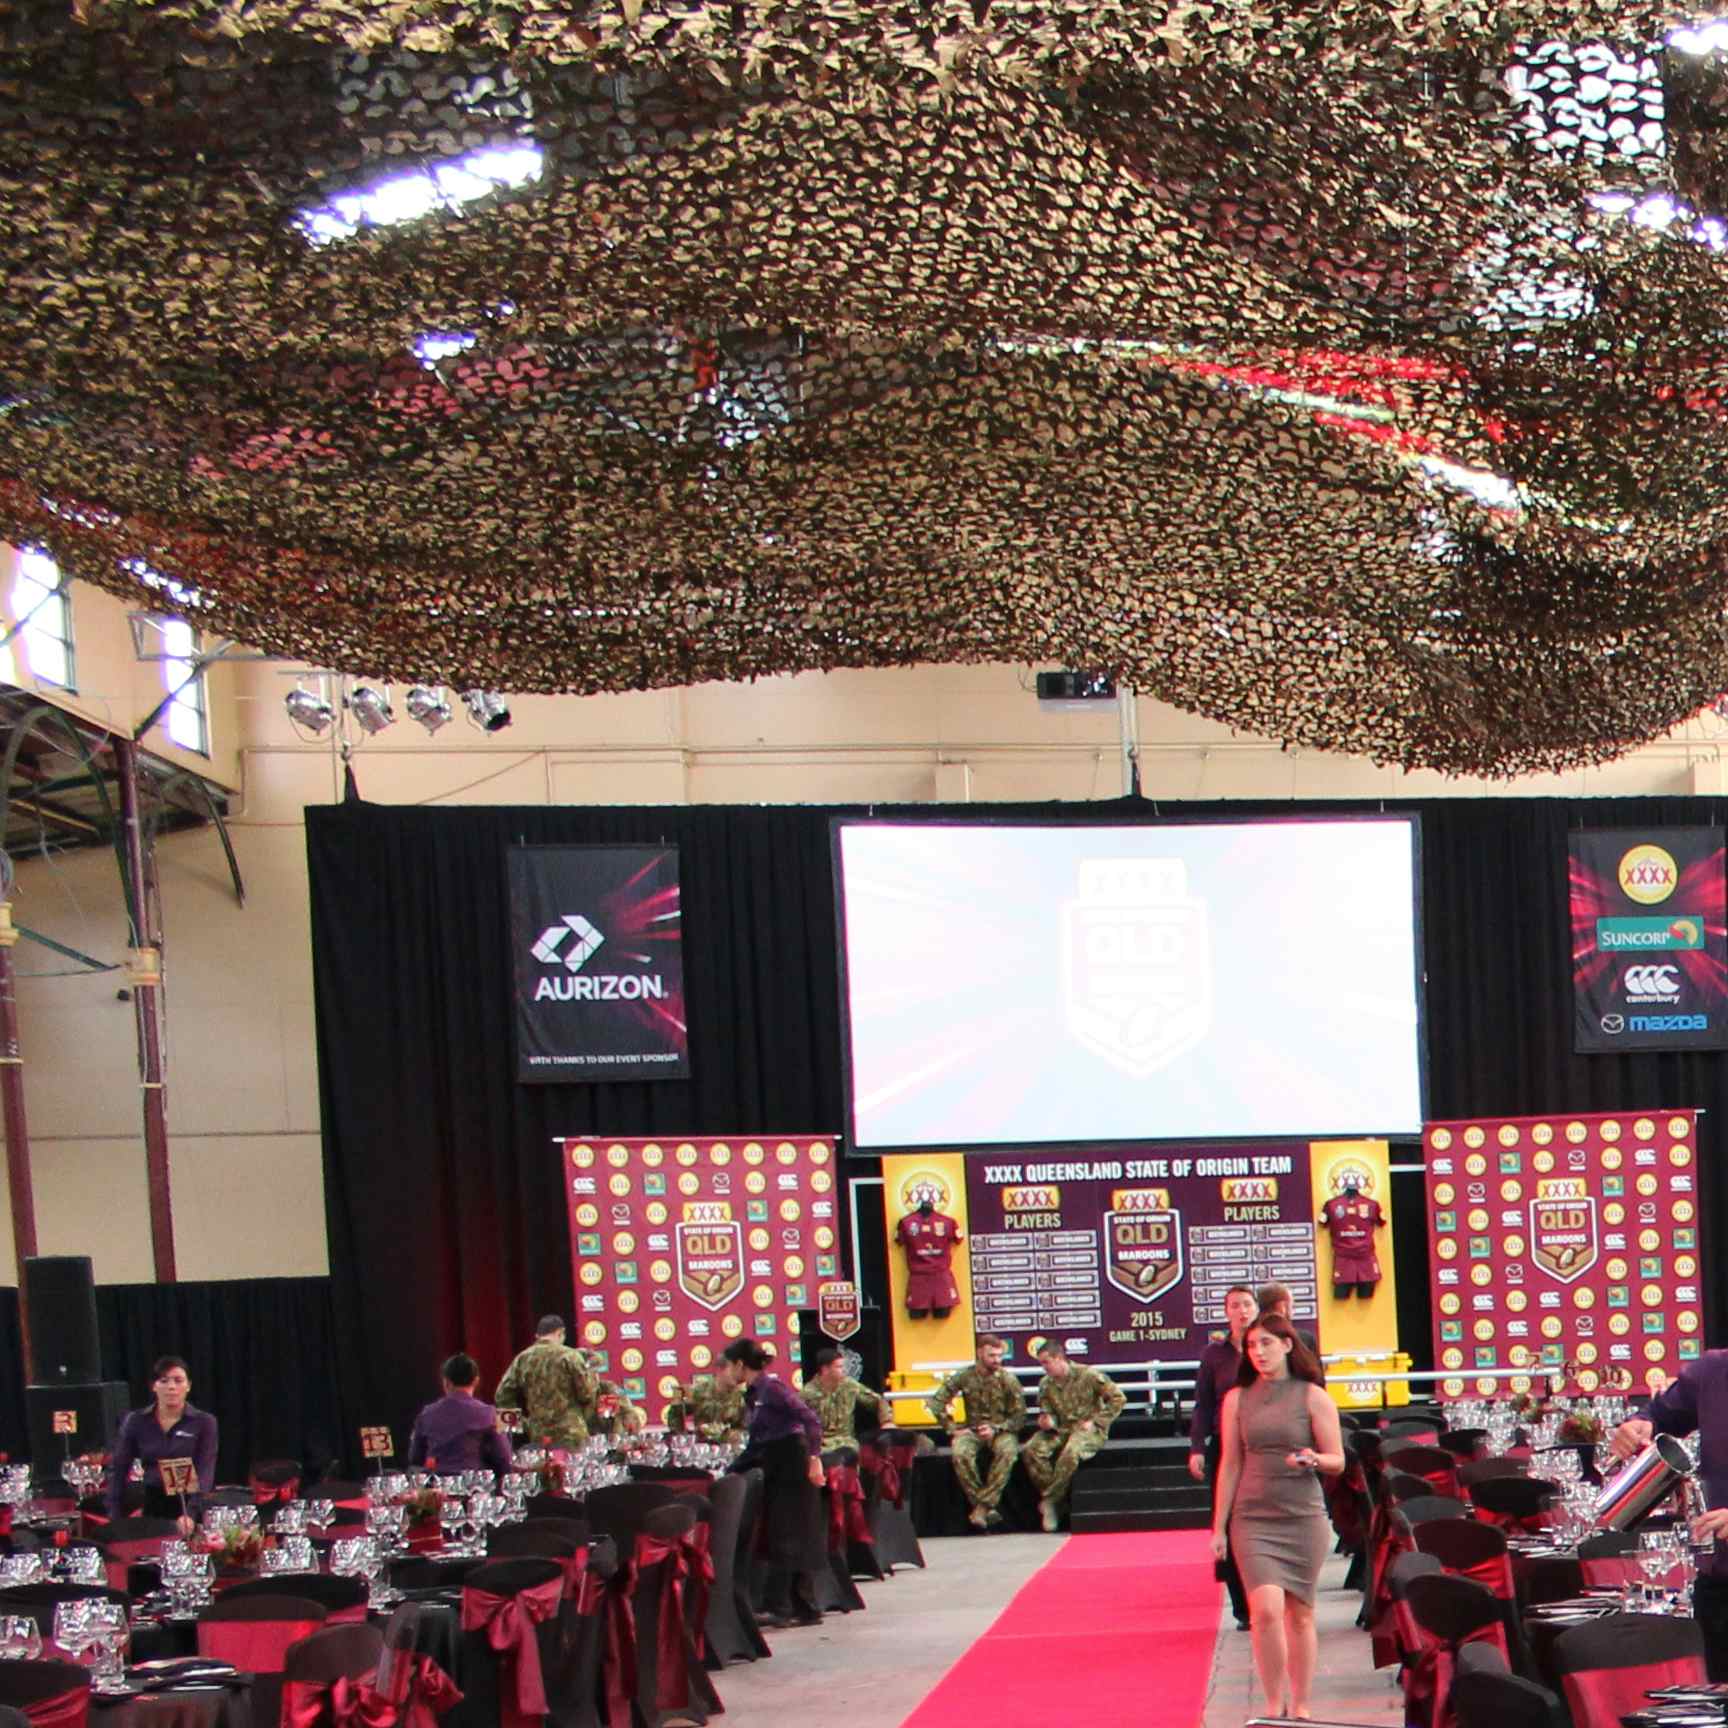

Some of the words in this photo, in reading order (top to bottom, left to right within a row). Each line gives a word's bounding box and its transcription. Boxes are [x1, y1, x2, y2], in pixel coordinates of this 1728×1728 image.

[1625, 867, 1673, 885] XXXX
[1602, 931, 1671, 946] SUNCORP
[534, 975, 665, 1002] AURIZON
[1629, 1015, 1708, 1031] mazda
[552, 1055, 585, 1065] THANKS
[586, 1055, 597, 1064] TO
[984, 1166, 1023, 1184] XXXX
[1026, 1161, 1123, 1183] QUEENSLAND
[1126, 1159, 1169, 1179] STATE
[1172, 1158, 1192, 1177] OF
[1195, 1157, 1249, 1176] ORIGIN
[1251, 1156, 1292, 1175] TEAM
[1007, 1190, 1055, 1208] XXXX
[1227, 1182, 1272, 1200] XXXX
[1119, 1192, 1163, 1210] XXXX
[1004, 1213, 1062, 1229] PLAYERS
[1224, 1205, 1280, 1222] PLAYERS
[1540, 1211, 1586, 1231] QLD
[1116, 1224, 1169, 1245] QLD
[687, 1235, 731, 1255] QLD
[1118, 1250, 1170, 1261] MAROONS
[1130, 1312, 1164, 1328] 2015
[1109, 1331, 1137, 1343] GAME
[362, 1433, 390, 1451] 13
[162, 1465, 193, 1490] 17
